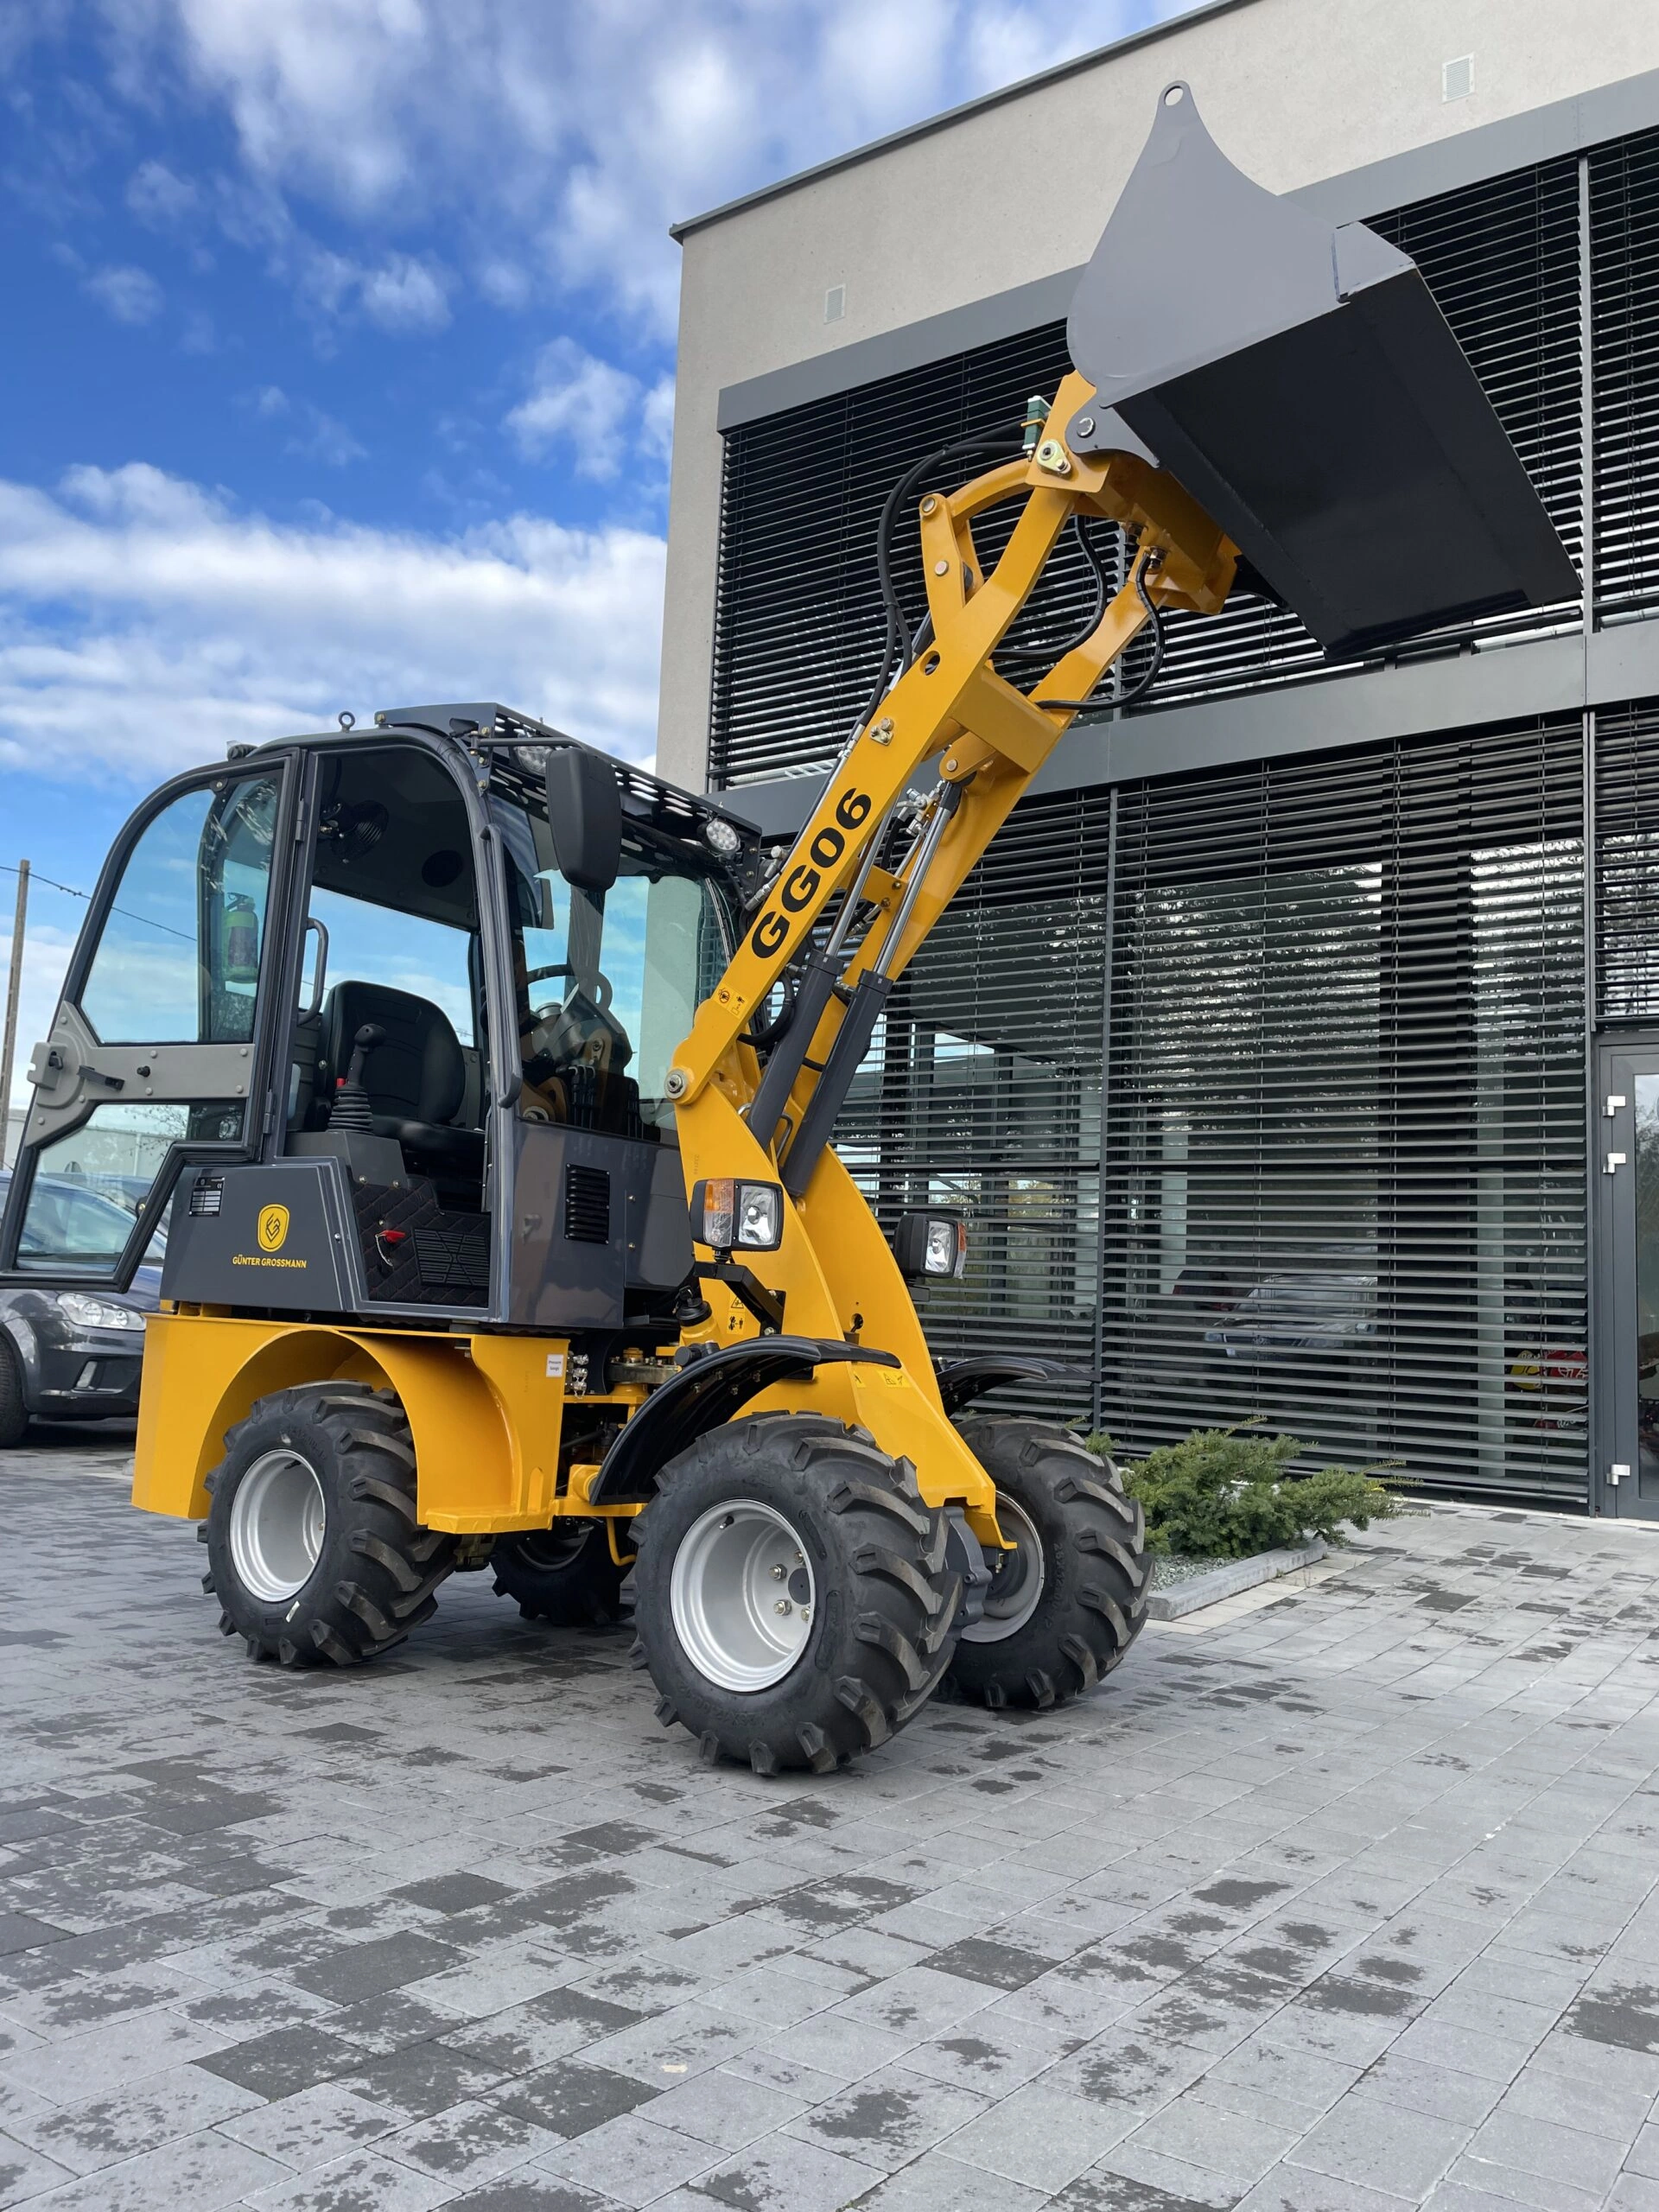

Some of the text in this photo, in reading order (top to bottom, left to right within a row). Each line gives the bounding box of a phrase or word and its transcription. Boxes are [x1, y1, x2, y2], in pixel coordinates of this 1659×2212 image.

[752, 788, 871, 958] GG06
[232, 1255, 307, 1268] GÜNTER GROSSMANN
